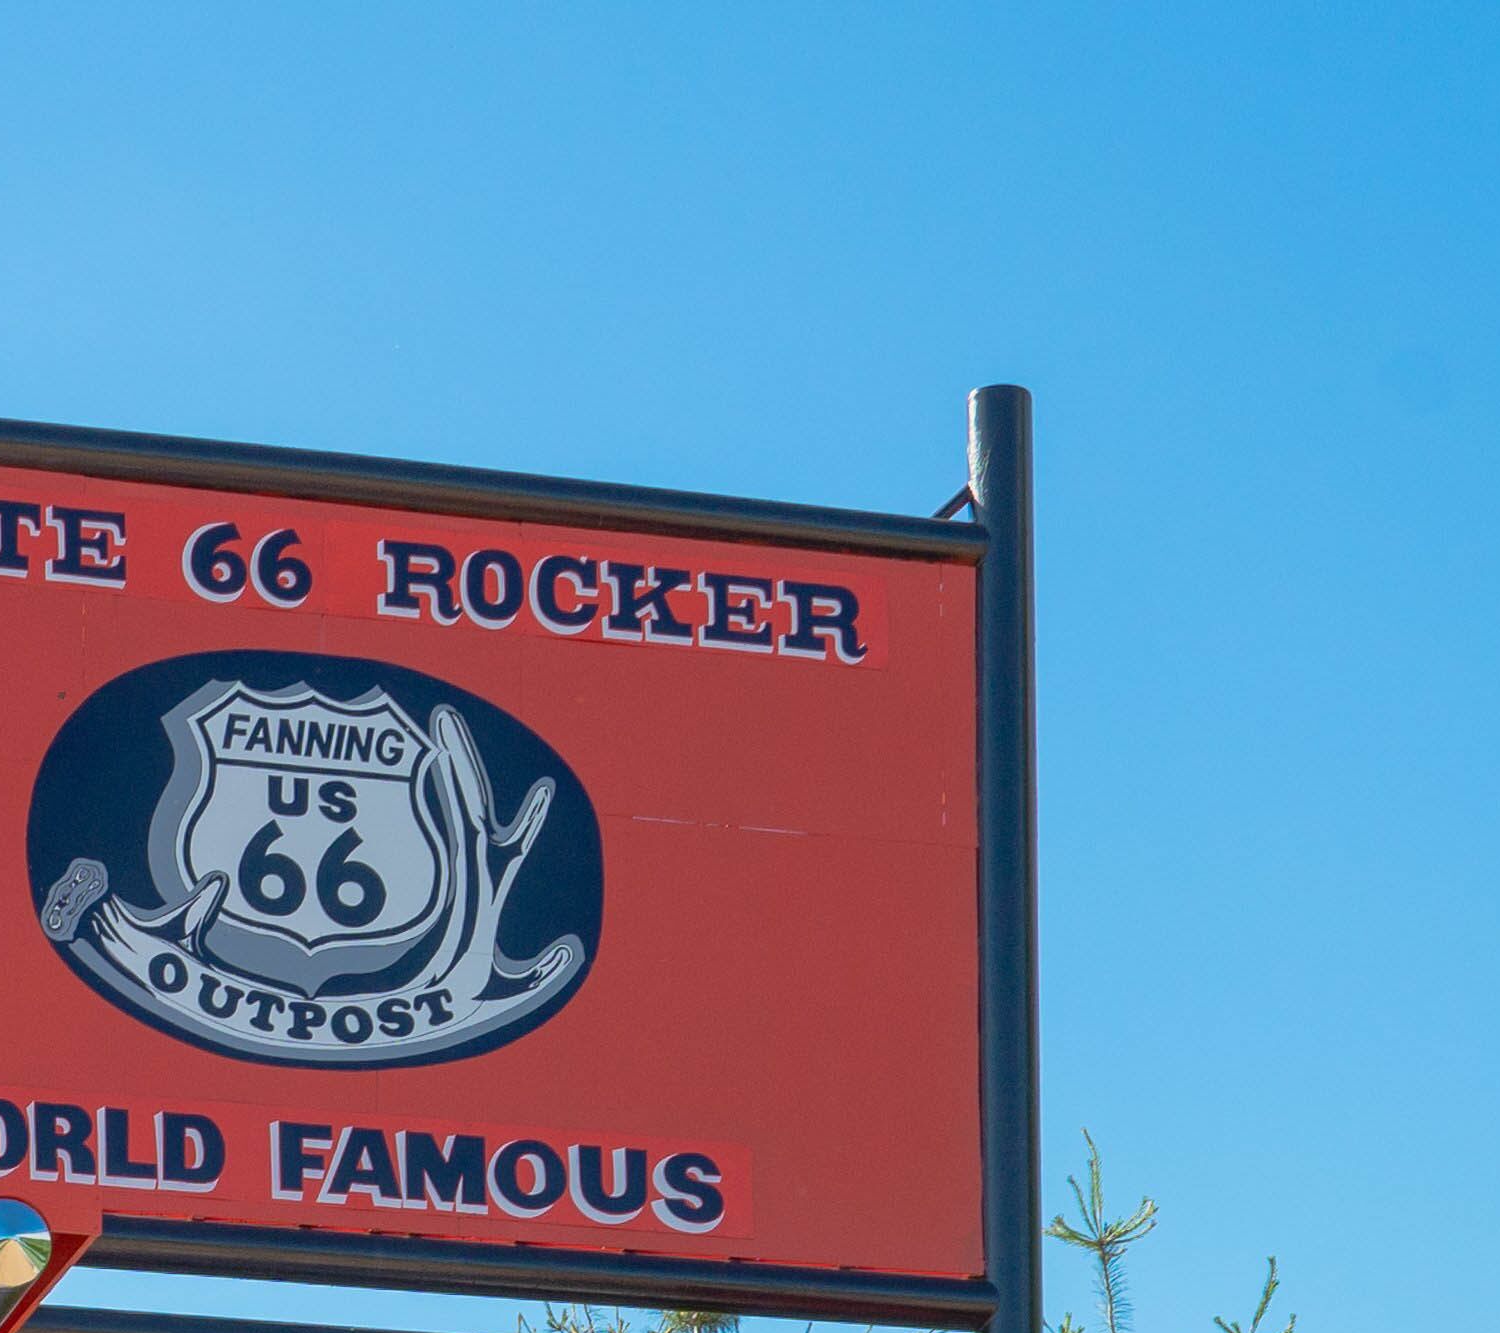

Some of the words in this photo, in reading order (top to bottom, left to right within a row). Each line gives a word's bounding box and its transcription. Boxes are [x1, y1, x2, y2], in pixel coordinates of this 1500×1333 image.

[181, 521, 313, 608] 66
[376, 538, 868, 665] ROCKER
[222, 713, 405, 766] FANNING
[267, 775, 358, 823] US
[238, 819, 387, 928] 66
[149, 952, 453, 1044] OUTPOST
[269, 1119, 726, 1233] FAMOUS
